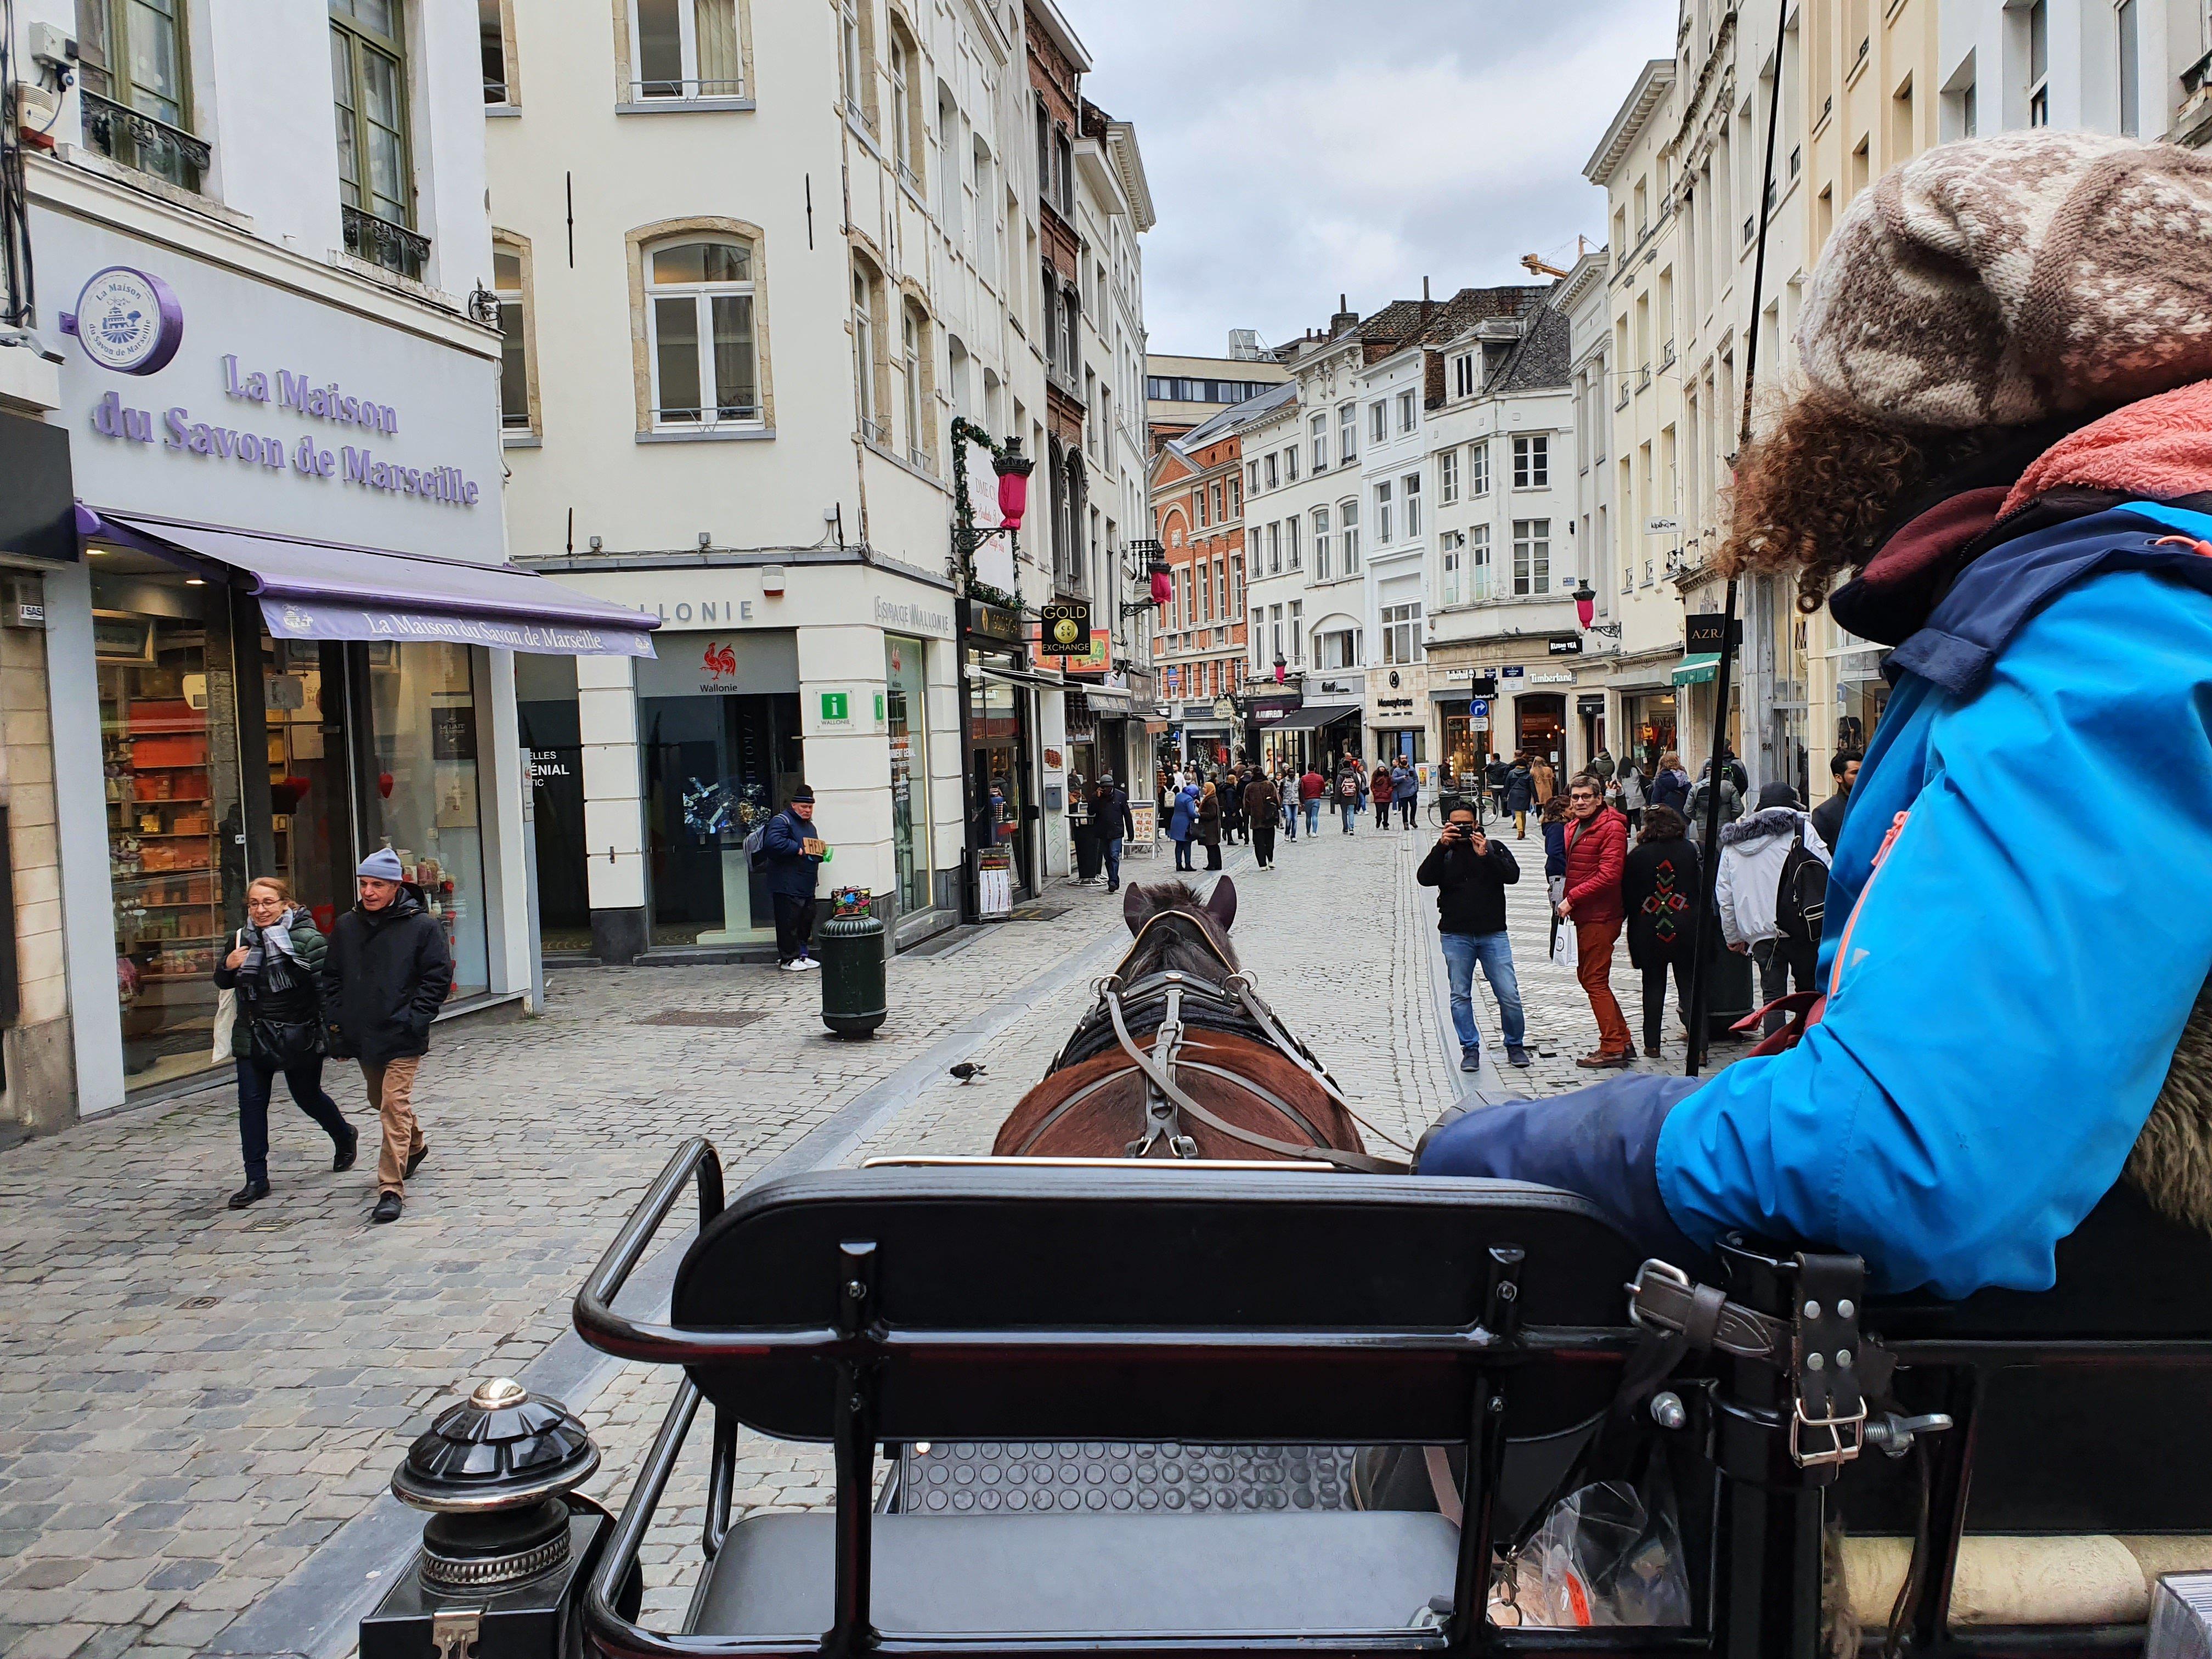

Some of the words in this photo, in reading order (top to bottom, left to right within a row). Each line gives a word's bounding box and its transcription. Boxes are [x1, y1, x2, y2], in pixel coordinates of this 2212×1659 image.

[95, 291, 107, 301] La
[109, 283, 142, 300] Maison
[89, 324, 96, 335] du
[94, 336, 114, 355] Savon
[127, 319, 151, 354] Marseille
[223, 354, 271, 402] La
[277, 369, 399, 433] Maison
[93, 391, 154, 443] du
[163, 407, 286, 468] Savon
[292, 435, 335, 477] de
[341, 445, 479, 505] Marseille
[640, 601, 753, 622] LONIE
[1043, 606, 1087, 619] GOLD
[362, 613, 393, 633] La
[389, 614, 461, 636] Maison
[459, 619, 483, 639] du
[478, 622, 522, 646] Savon
[524, 625, 540, 646] de
[540, 628, 603, 649] Marseille
[1691, 629, 1724, 639] AZR
[1042, 643, 1089, 652] EXCHANGE
[1530, 673, 1572, 683] Timberland
[699, 684, 737, 692] Wallonie
[531, 762, 570, 776] ÉNIAL
